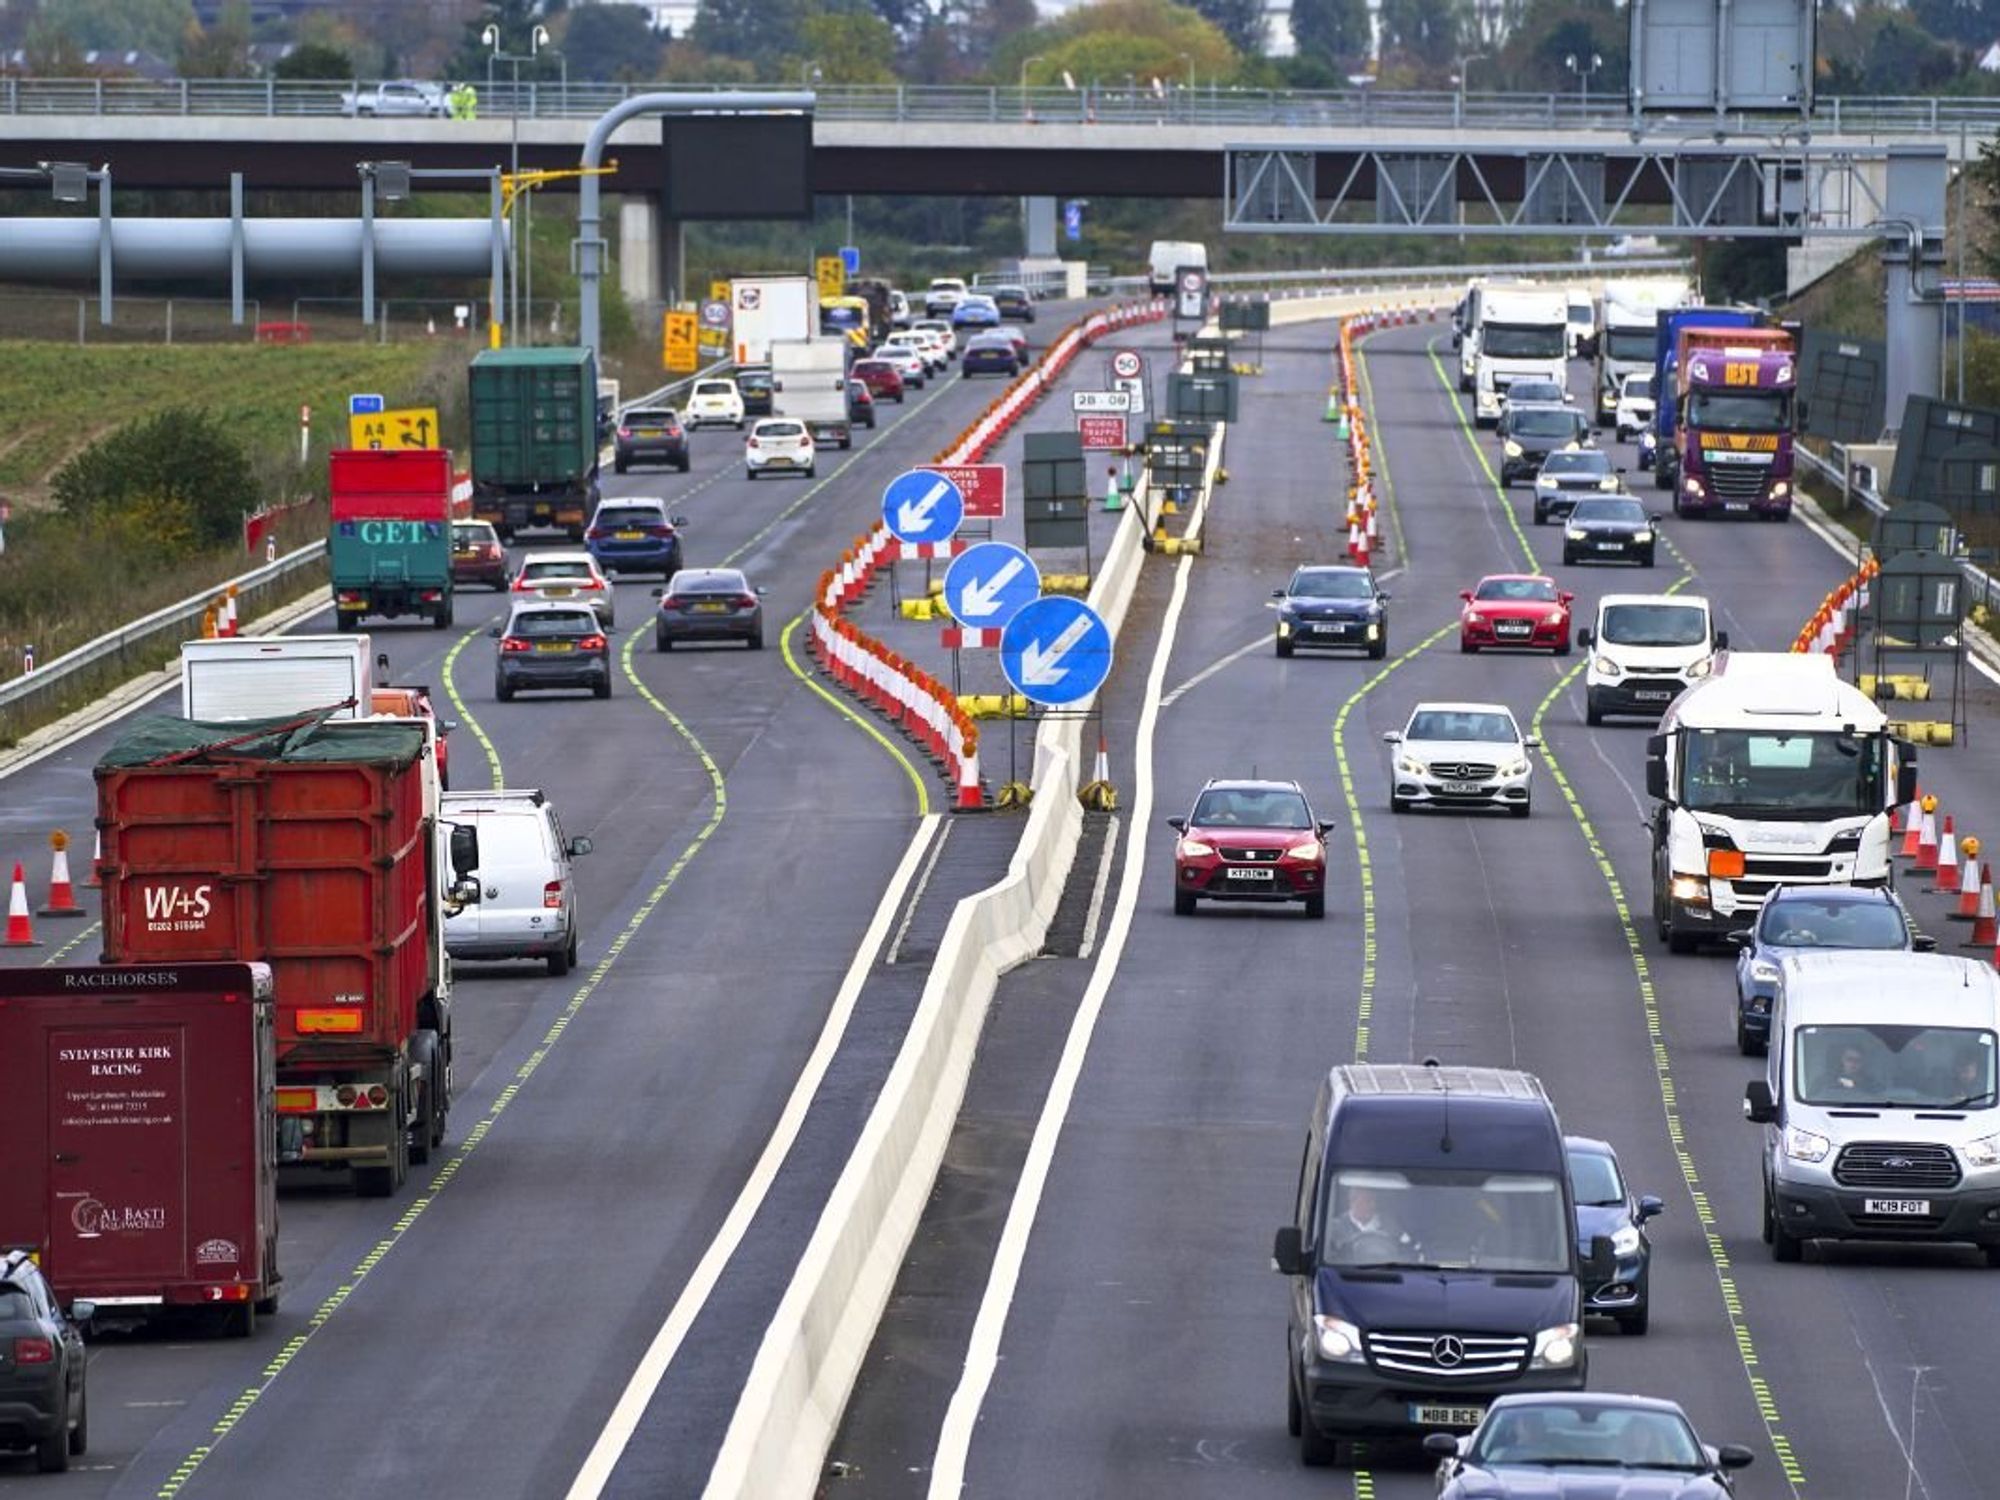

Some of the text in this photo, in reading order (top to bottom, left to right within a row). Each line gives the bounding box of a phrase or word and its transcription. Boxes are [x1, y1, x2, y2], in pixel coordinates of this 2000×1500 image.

[1118, 358, 1137, 371] 50
[1085, 420, 1119, 428] WORKS
[1088, 436, 1115, 446] ONLY
[144, 885, 211, 919] W+S
[64, 972, 179, 987] RACEHORSES
[60, 1046, 171, 1061] SYLVESTER KIRK
[91, 1063, 142, 1076] RACING
[125, 1206, 165, 1220] BASTI
